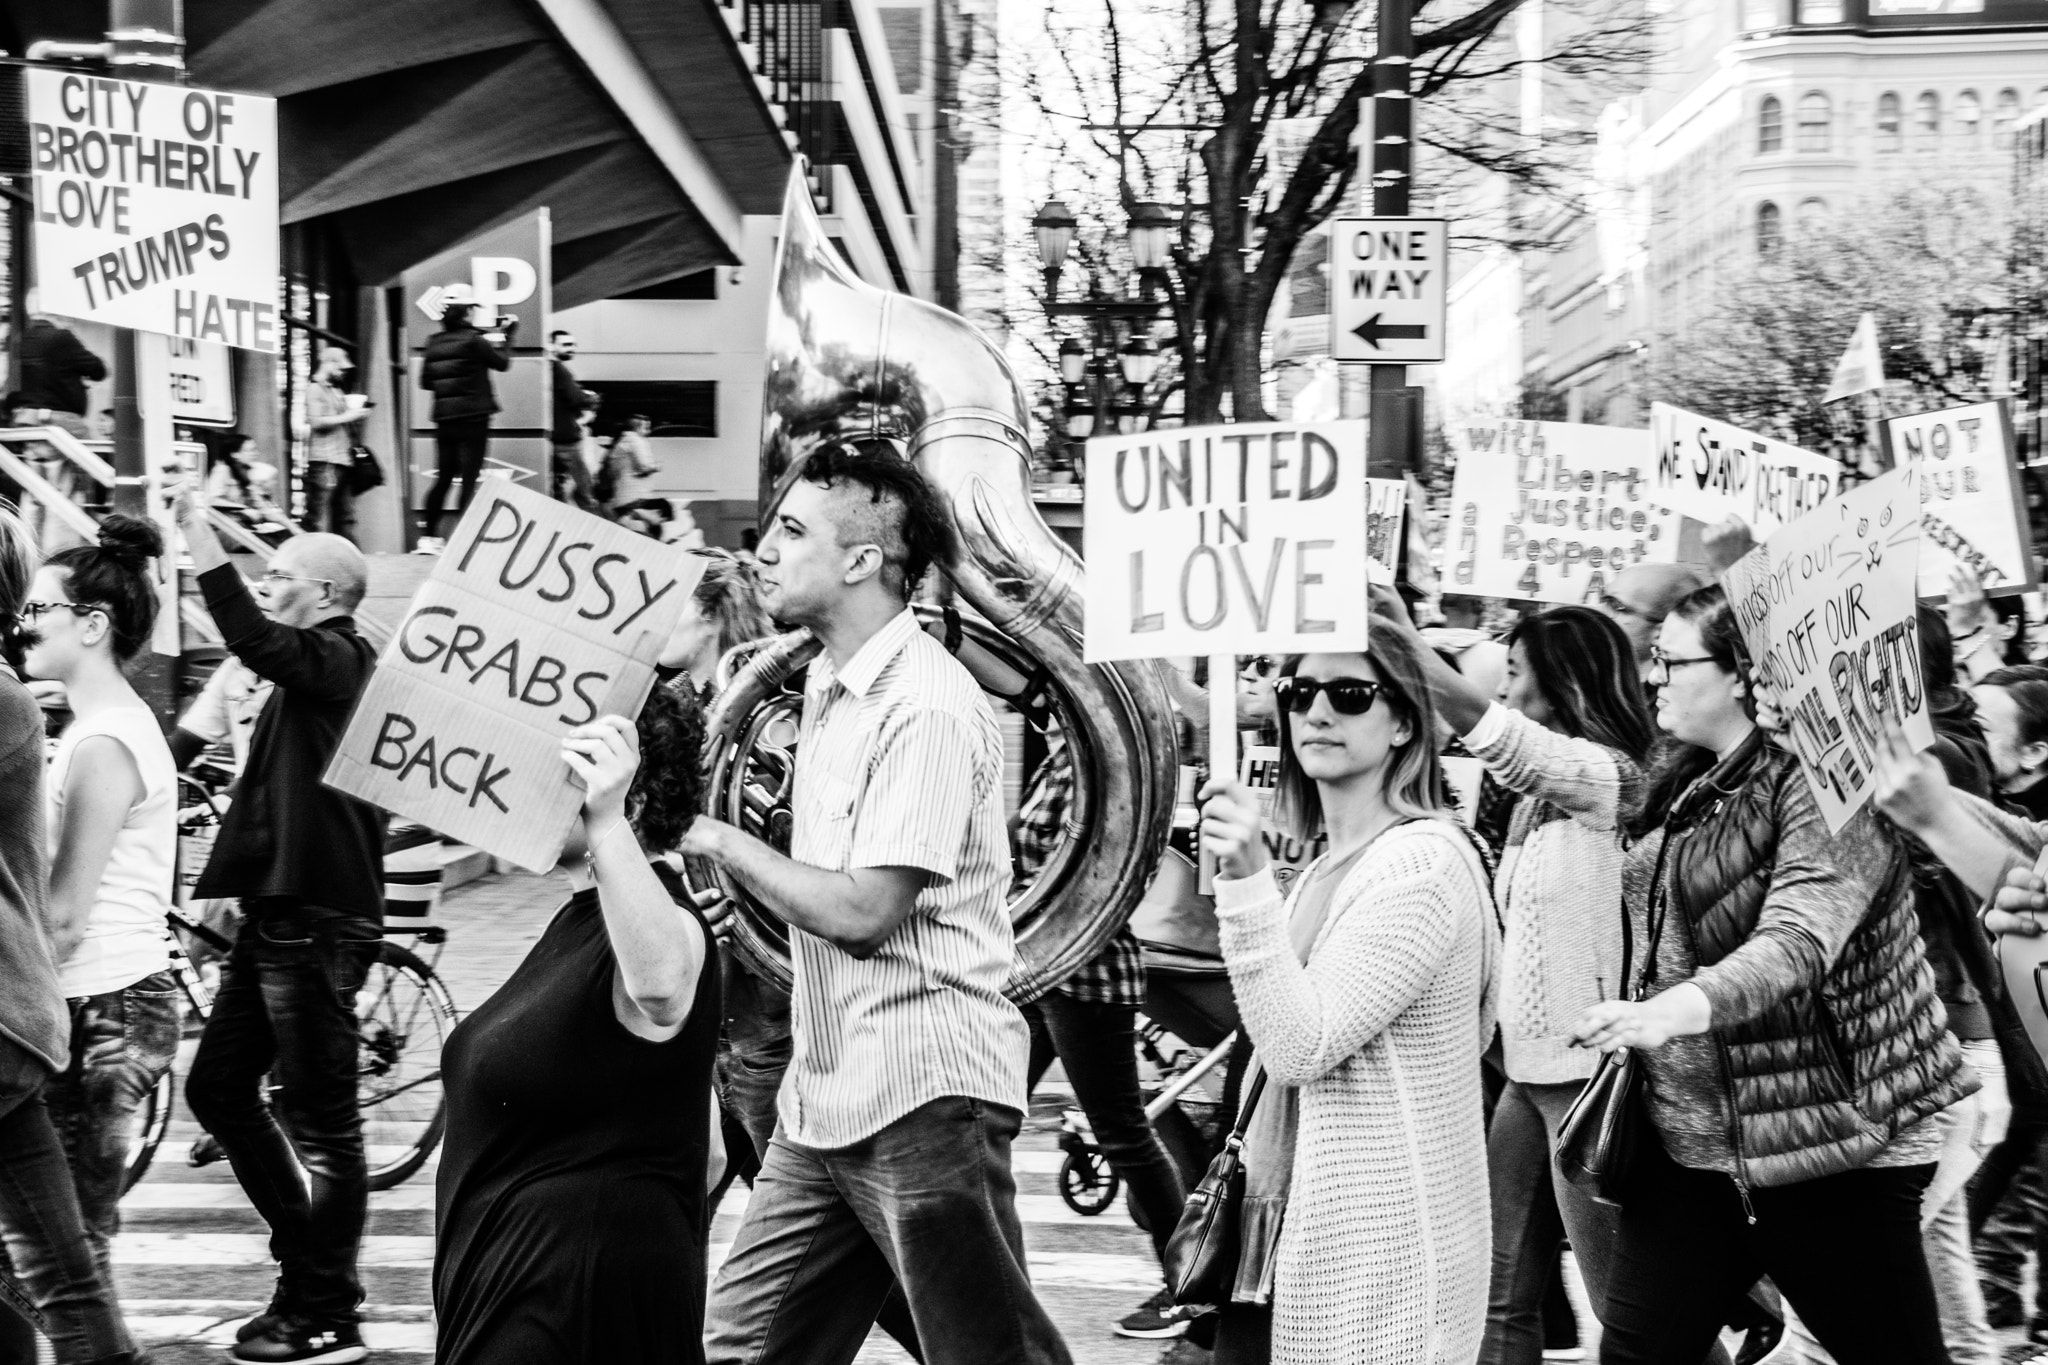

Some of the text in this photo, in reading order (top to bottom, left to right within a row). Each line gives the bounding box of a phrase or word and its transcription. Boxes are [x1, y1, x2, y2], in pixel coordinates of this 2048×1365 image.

[61, 75, 234, 144] CITY OF
[31, 122, 260, 199] BROTHERLY
[33, 174, 130, 235] LOVE
[73, 213, 230, 310] TRUMPS
[1353, 231, 1428, 261] ONE
[174, 288, 275, 350] HATE
[471, 257, 537, 327] P
[1349, 269, 1432, 300] WAY
[1114, 430, 1339, 515] UNITED
[1467, 421, 1546, 458] with
[1652, 414, 1681, 489] WE
[1691, 426, 1750, 497] STAND
[1904, 418, 1981, 462] NOT
[1517, 454, 1656, 510] Libert
[1199, 505, 1248, 545] IN
[1502, 525, 1648, 578] Respect
[456, 498, 678, 636] PUSSY
[1129, 537, 1336, 635] LOVE
[1517, 562, 1541, 598] 4
[1787, 607, 1816, 676] OFF
[1825, 582, 1871, 647] OUR
[399, 605, 609, 727] GRABS
[1828, 614, 1922, 775] RIGHTS
[370, 712, 511, 815] BACK
